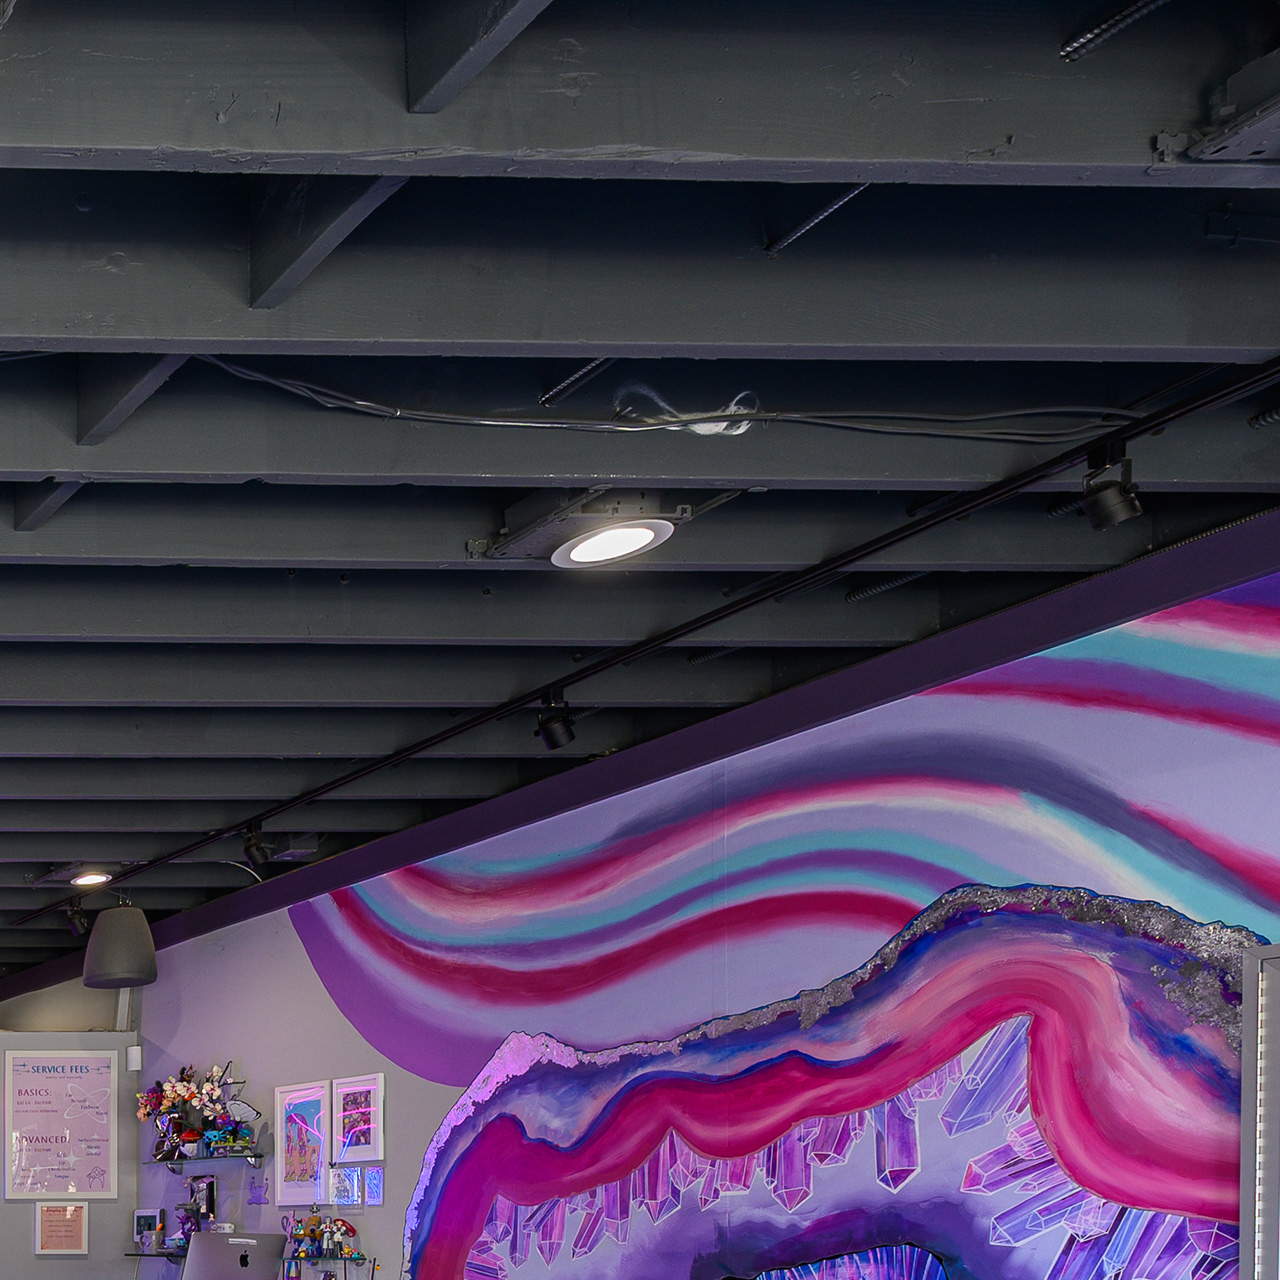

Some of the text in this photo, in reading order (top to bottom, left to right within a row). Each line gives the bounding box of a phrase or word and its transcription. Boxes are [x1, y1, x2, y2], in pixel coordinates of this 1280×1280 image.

[31, 1065, 90, 1074] SERVICE FEES
[17, 1089, 52, 1097] BASICS:
